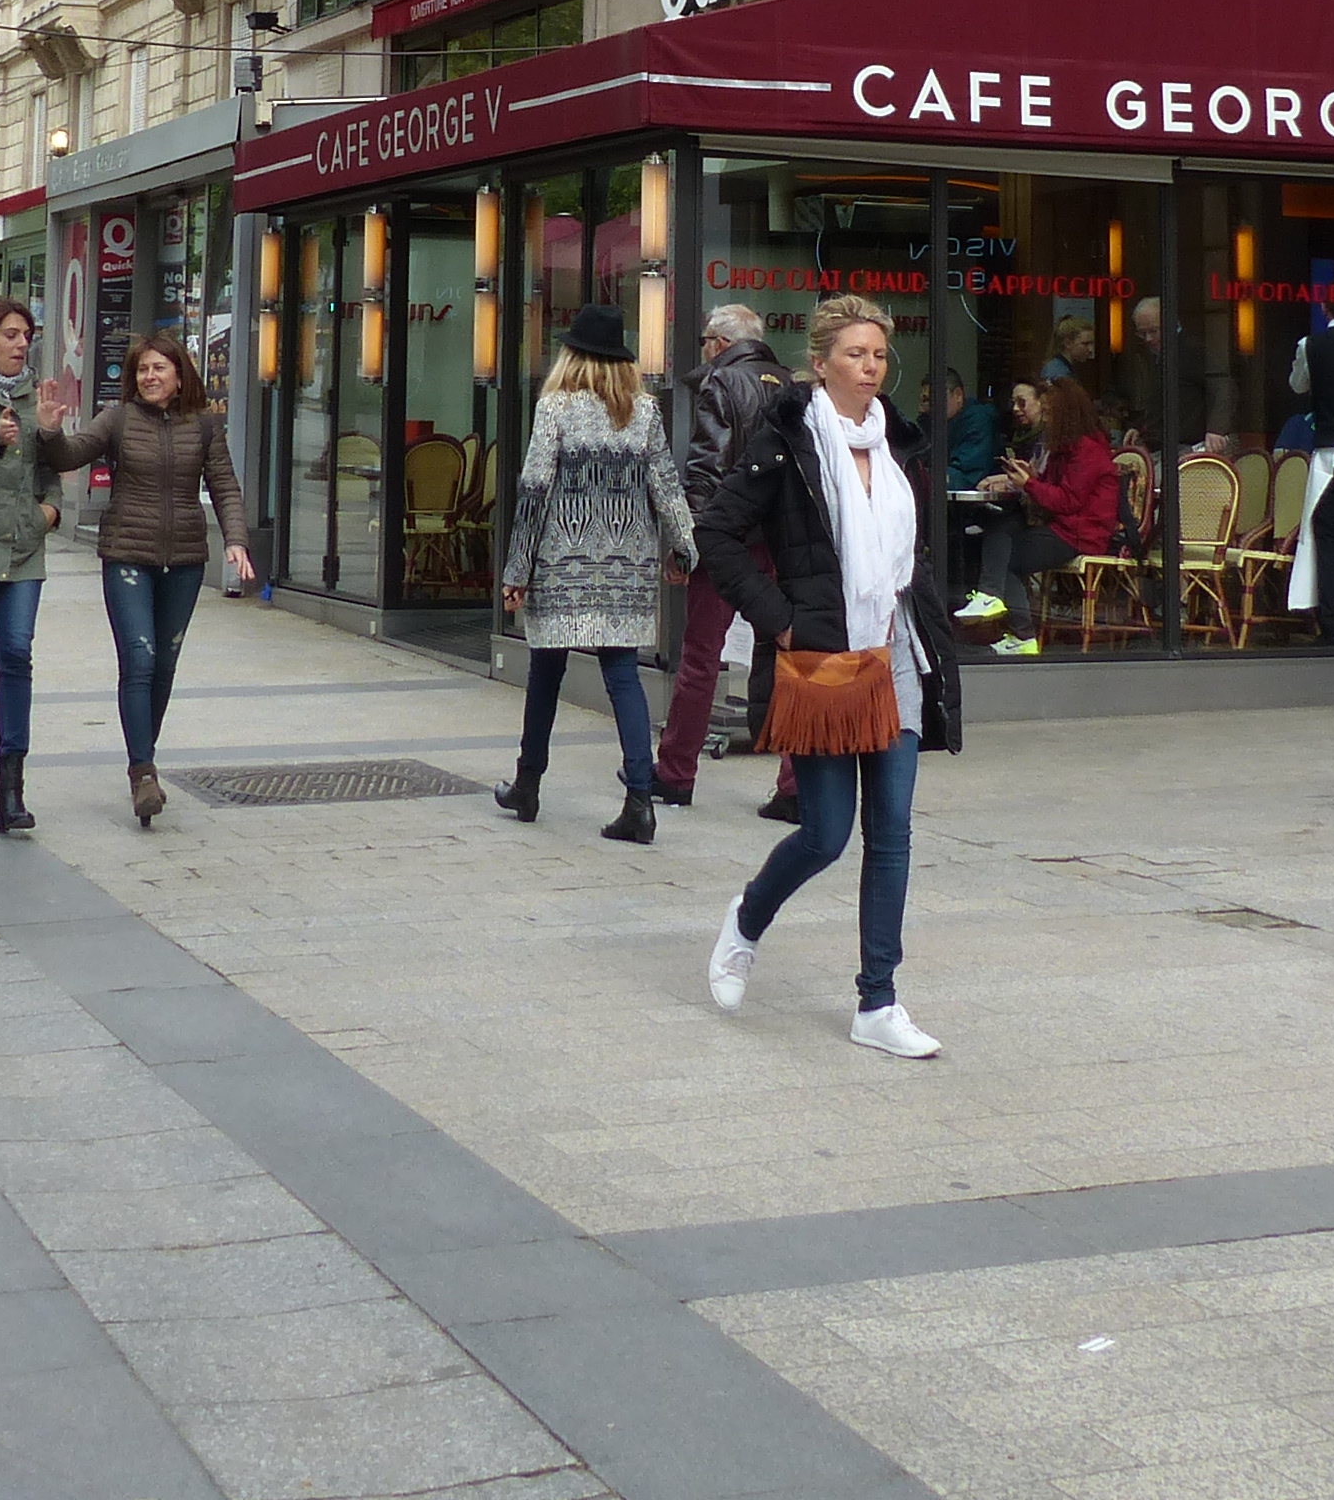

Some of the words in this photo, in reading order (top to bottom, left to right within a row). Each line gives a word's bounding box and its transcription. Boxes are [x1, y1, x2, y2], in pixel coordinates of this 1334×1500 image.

[852, 64, 1052, 128] CAFE
[316, 122, 370, 176] CAFE
[376, 91, 475, 161] GEORGE
[484, 85, 503, 136] V
[103, 217, 135, 258] Q
[102, 261, 134, 272] Quick
[965, 266, 1135, 299] CAPPUCCINO
